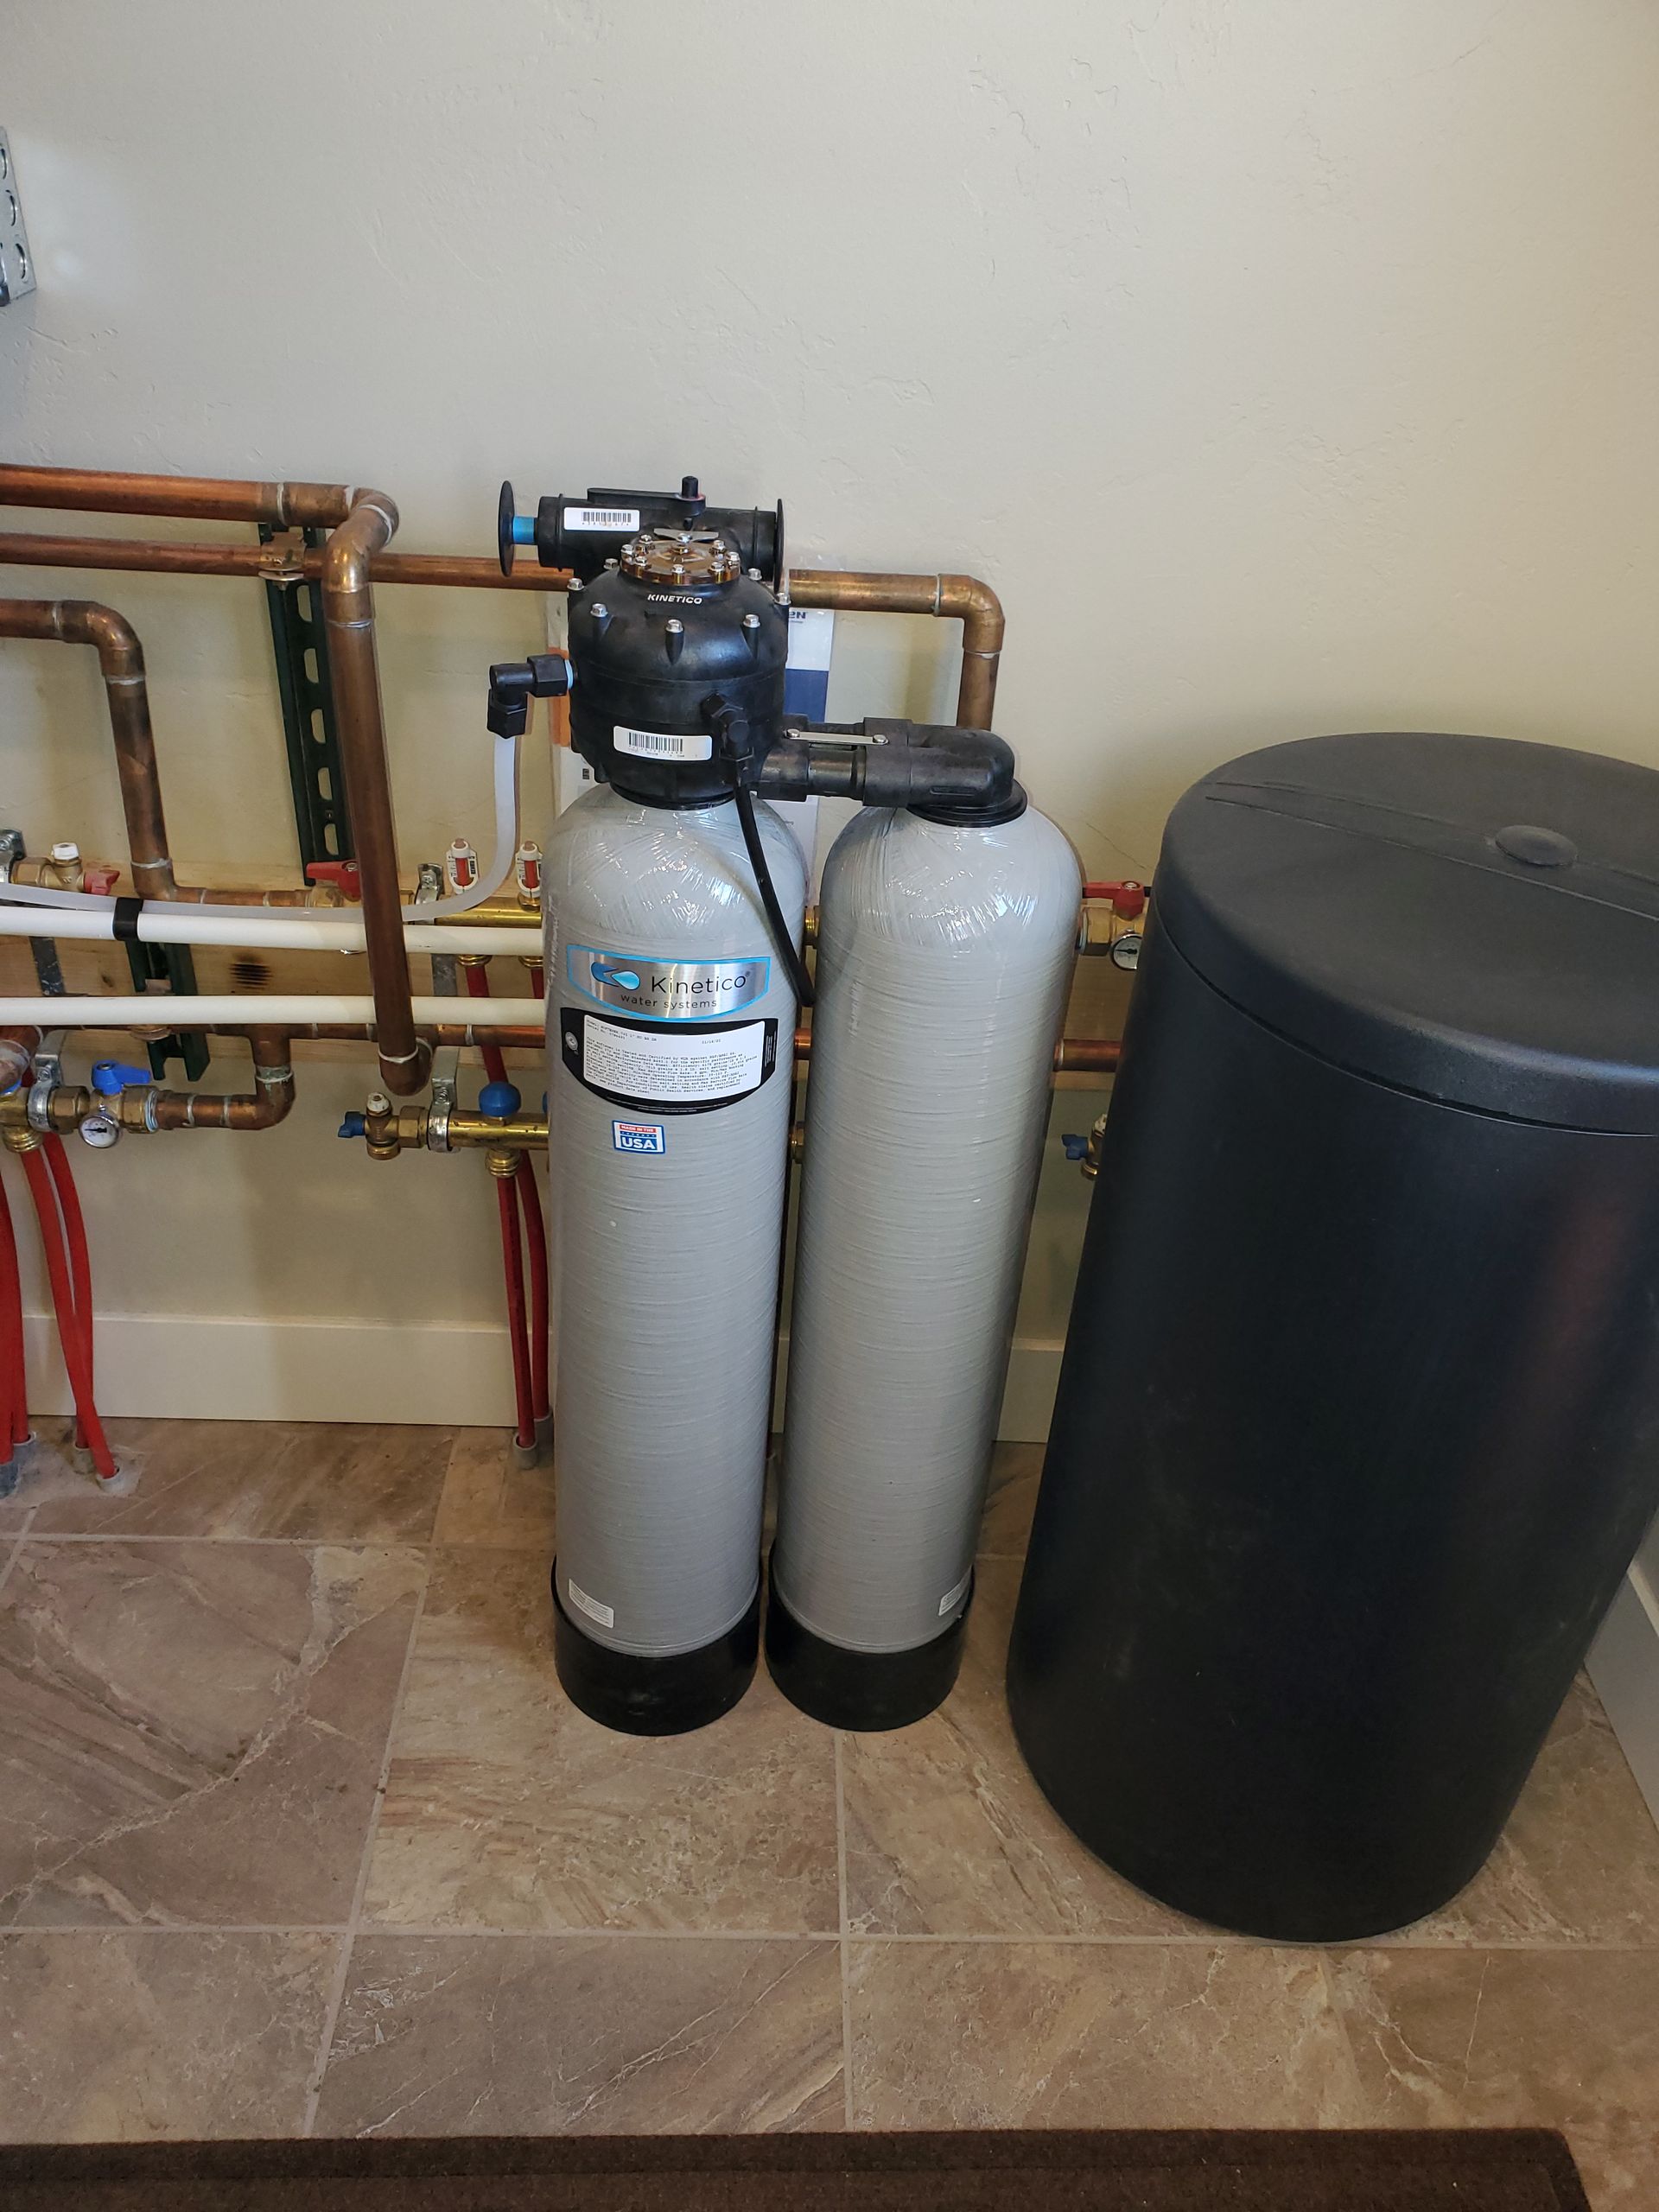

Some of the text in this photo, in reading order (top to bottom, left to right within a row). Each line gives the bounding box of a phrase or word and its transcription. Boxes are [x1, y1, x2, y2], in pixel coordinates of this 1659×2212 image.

[647, 594, 702, 605] KINETICO
[620, 994, 717, 1012] water systems
[621, 1136, 656, 1149] USA
